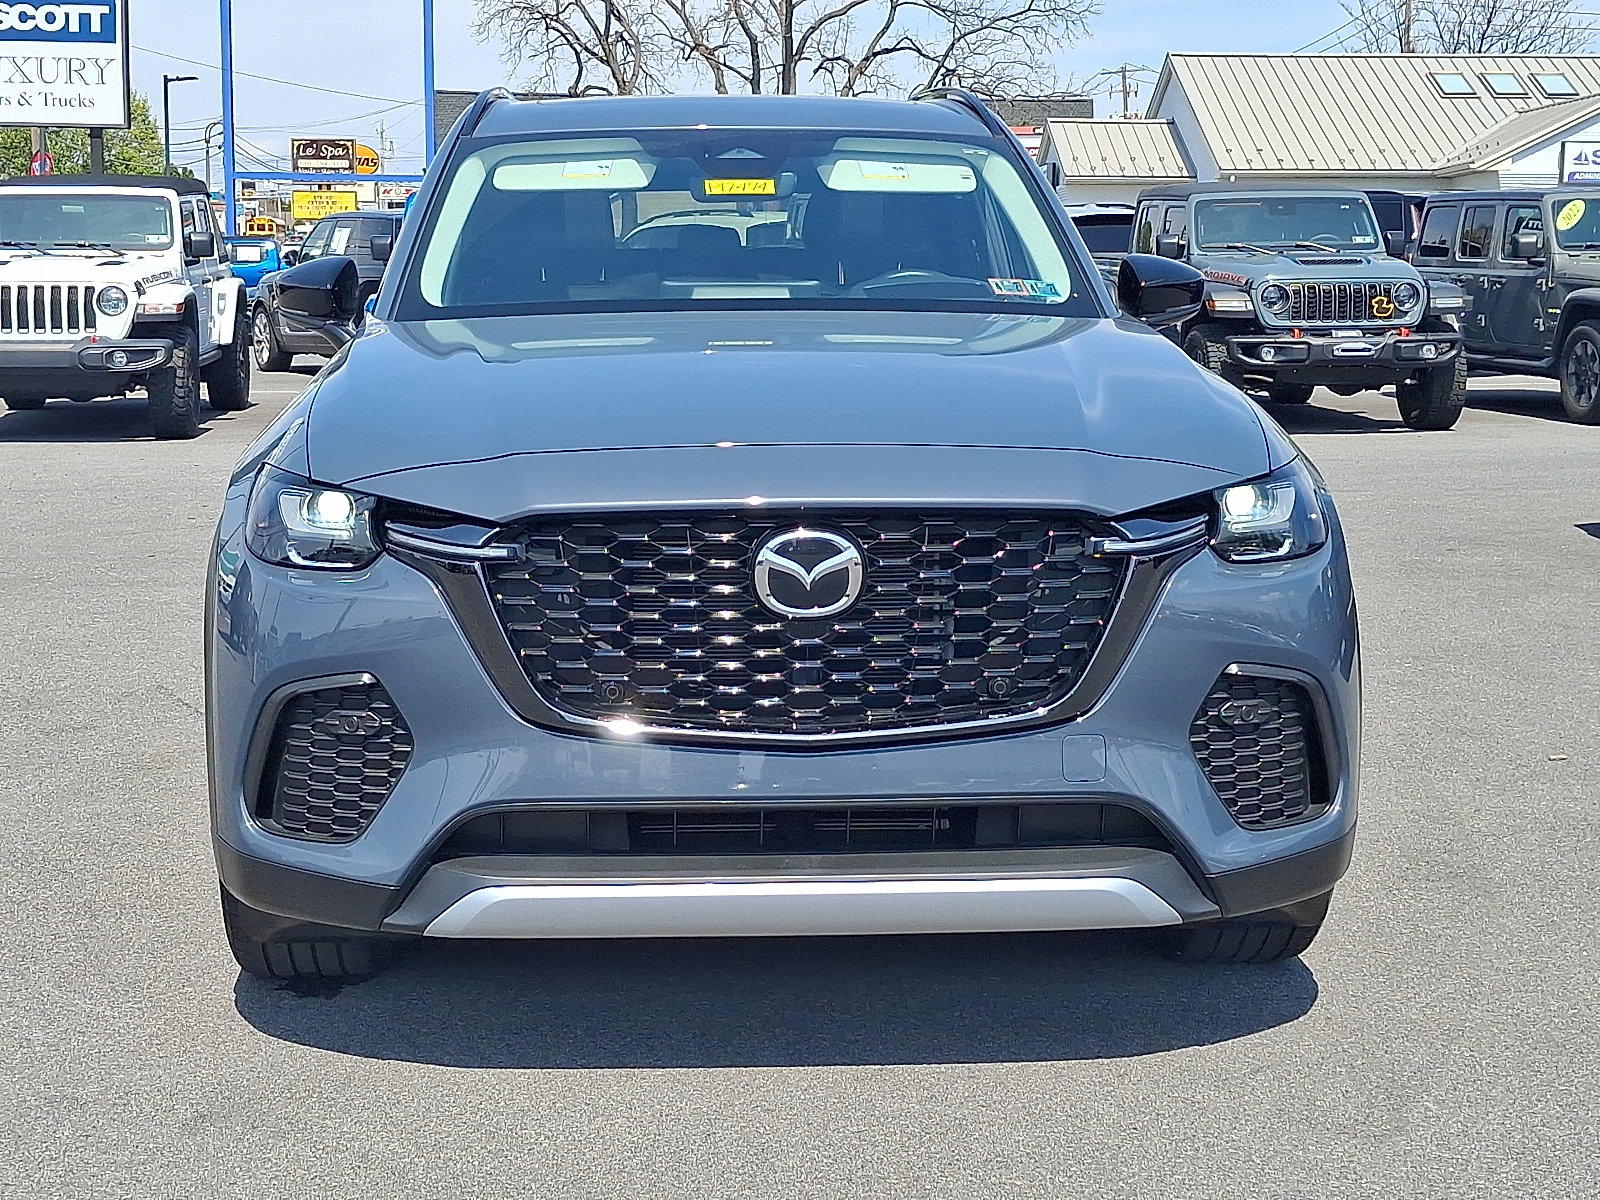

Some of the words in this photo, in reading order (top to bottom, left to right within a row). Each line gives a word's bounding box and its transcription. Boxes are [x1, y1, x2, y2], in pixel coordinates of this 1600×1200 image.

[0, 3, 111, 33] SCOTT
[0, 56, 116, 86] XURY
[17, 91, 32, 107] &
[38, 91, 95, 108] Trucks
[320, 144, 348, 159] Spa
[1204, 270, 1245, 284] MOJAVE
